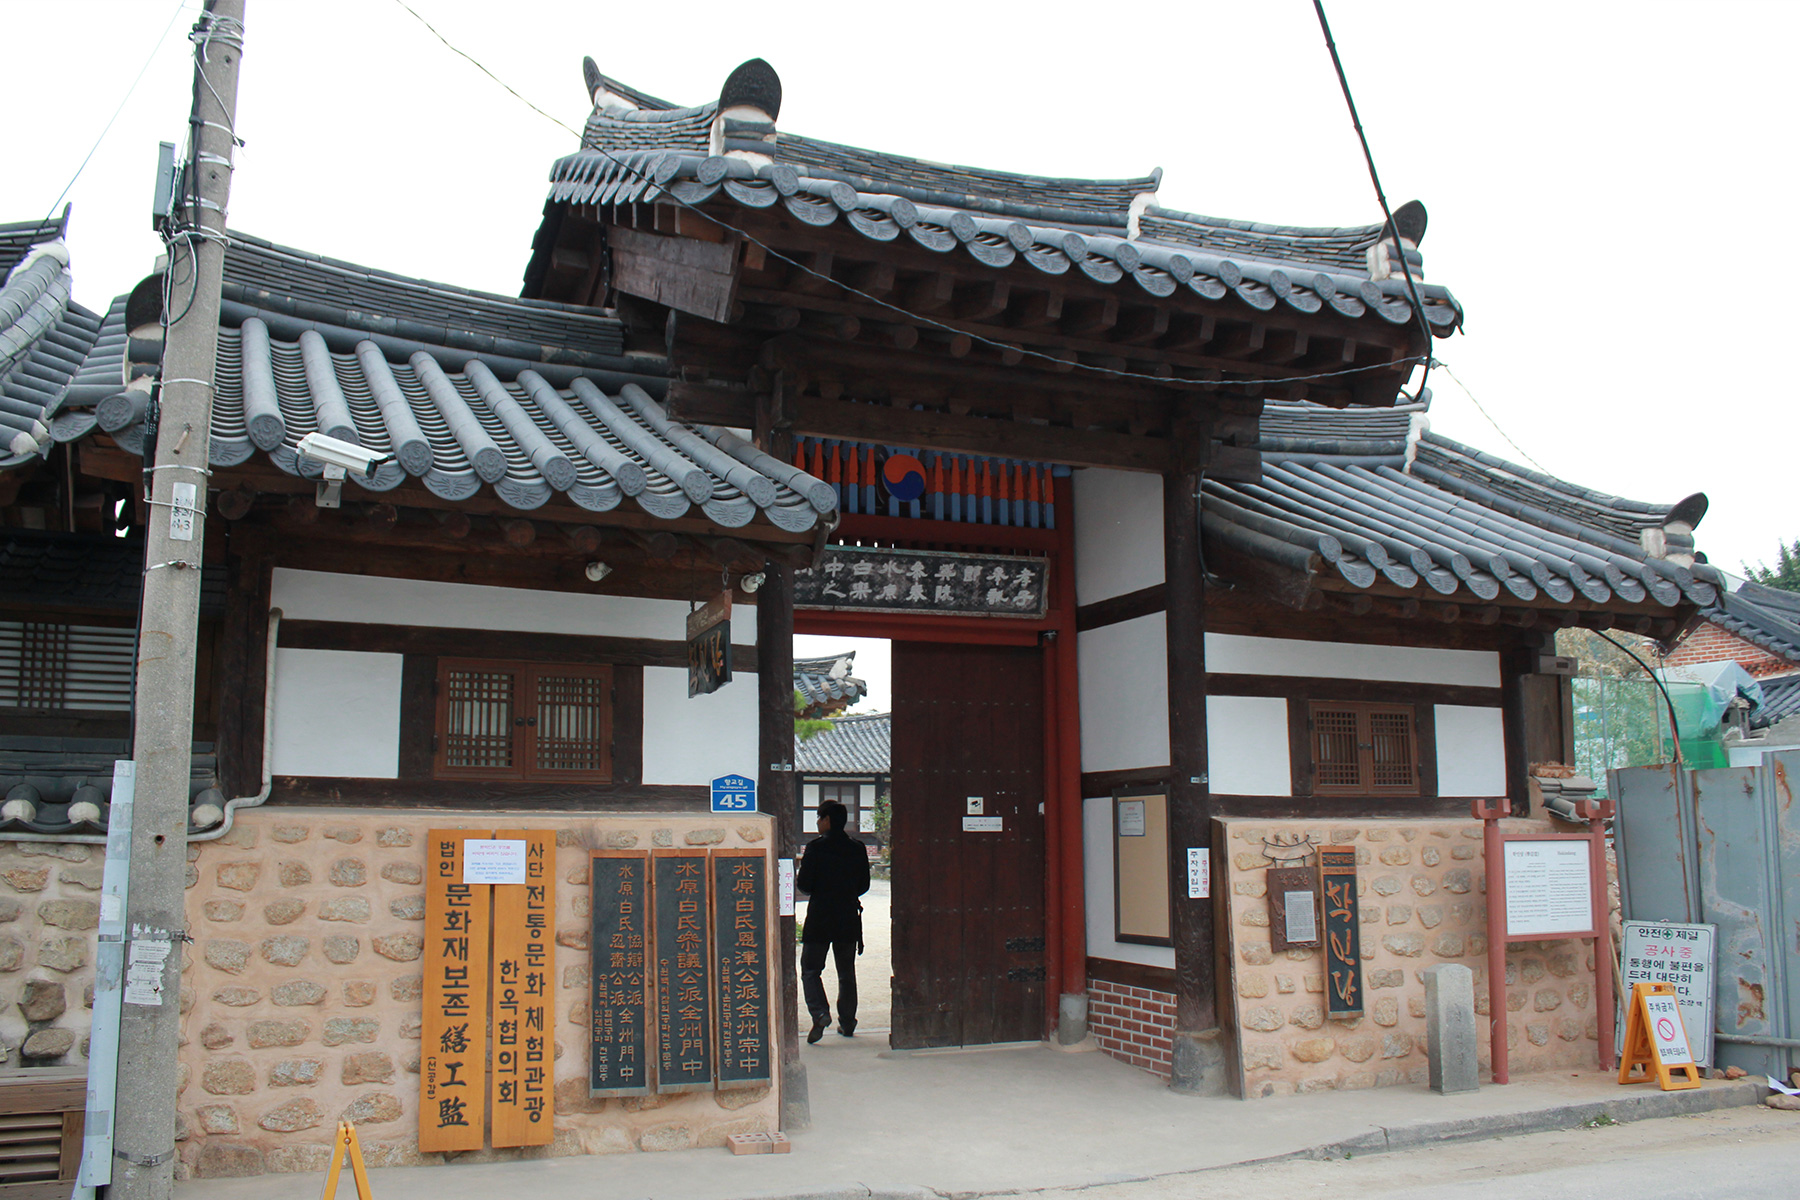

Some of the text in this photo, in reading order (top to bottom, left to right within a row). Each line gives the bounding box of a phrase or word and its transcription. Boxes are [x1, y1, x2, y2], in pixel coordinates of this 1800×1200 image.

[719, 793, 748, 809] 45
[440, 841, 455, 878] 법인
[528, 842, 545, 878] 사단
[618, 864, 634, 932] 水原白氏
[1638, 928, 1698, 941] 안전 제일
[441, 884, 472, 1017] 문화재보존
[1628, 970, 1692, 983] 드려 대단히
[1629, 958, 1704, 972] 통행에 불편을
[1648, 1002, 1675, 1012] 주차금지
[497, 959, 520, 1106] 한옥협의회
